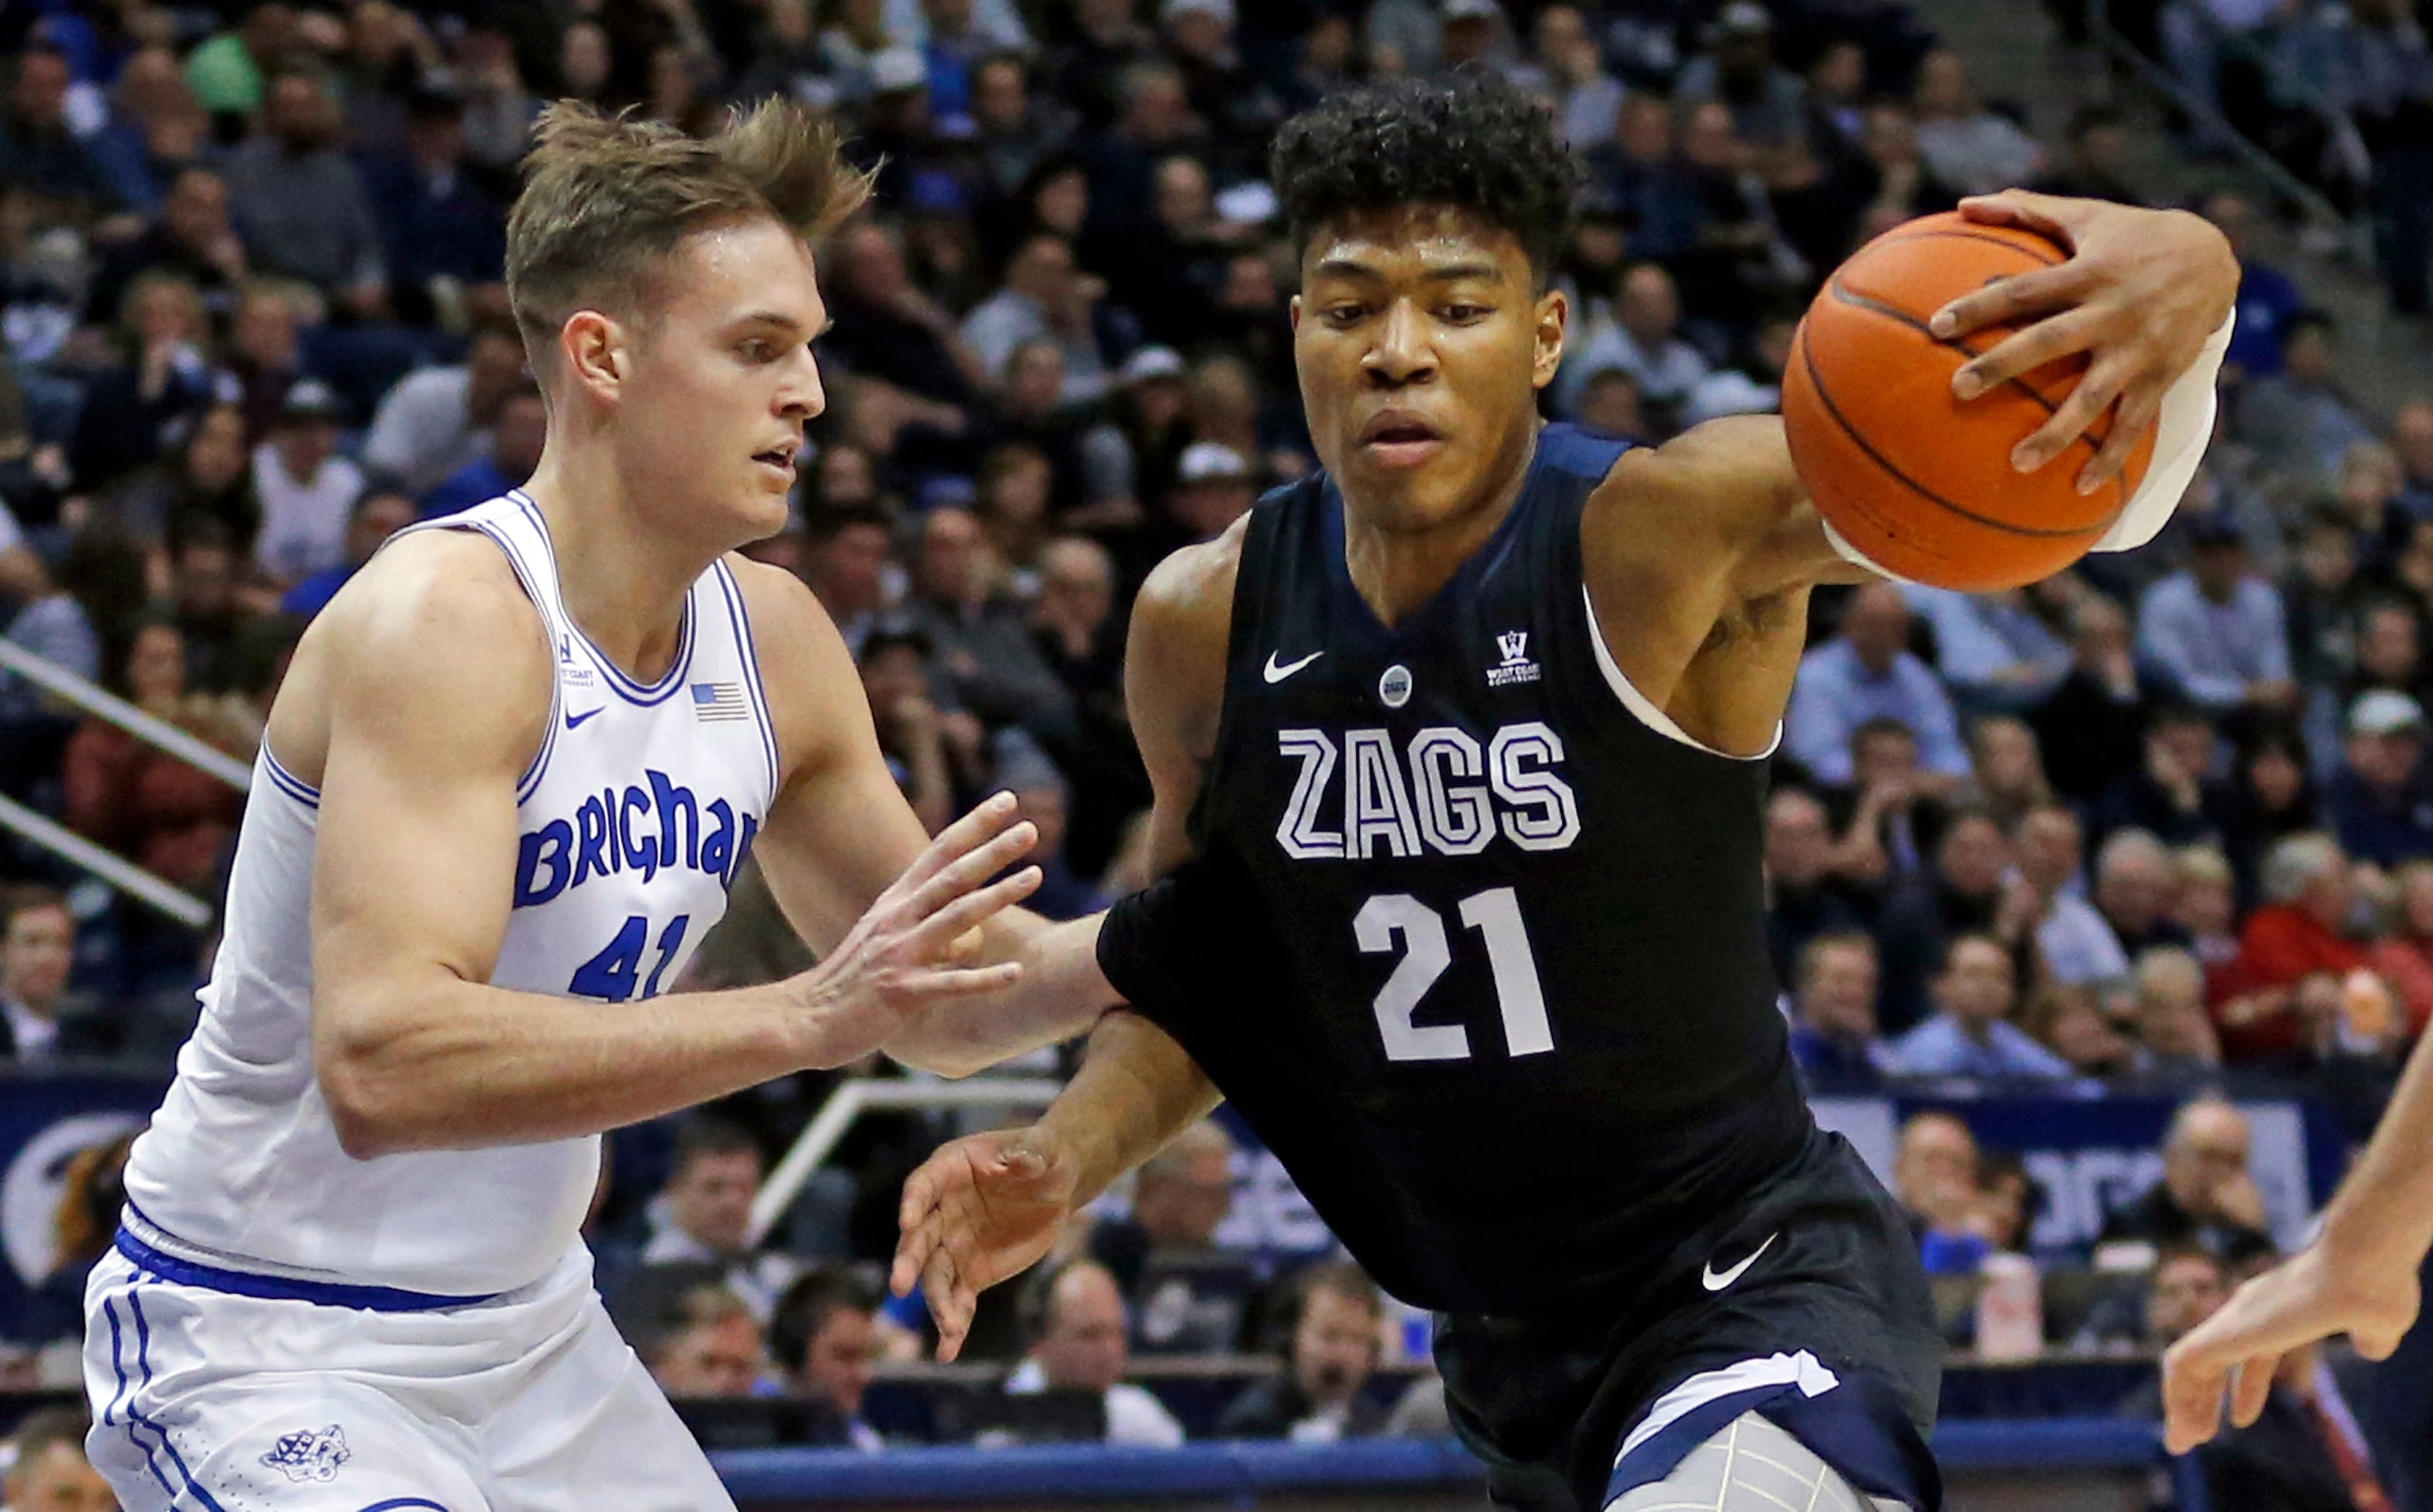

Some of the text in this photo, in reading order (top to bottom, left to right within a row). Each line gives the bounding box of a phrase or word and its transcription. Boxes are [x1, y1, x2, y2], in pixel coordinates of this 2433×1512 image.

[1496, 631, 1527, 660] W
[1276, 722, 1580, 859] ZAGS
[568, 914, 689, 1003] 41
[1352, 887, 1555, 1061] 21
